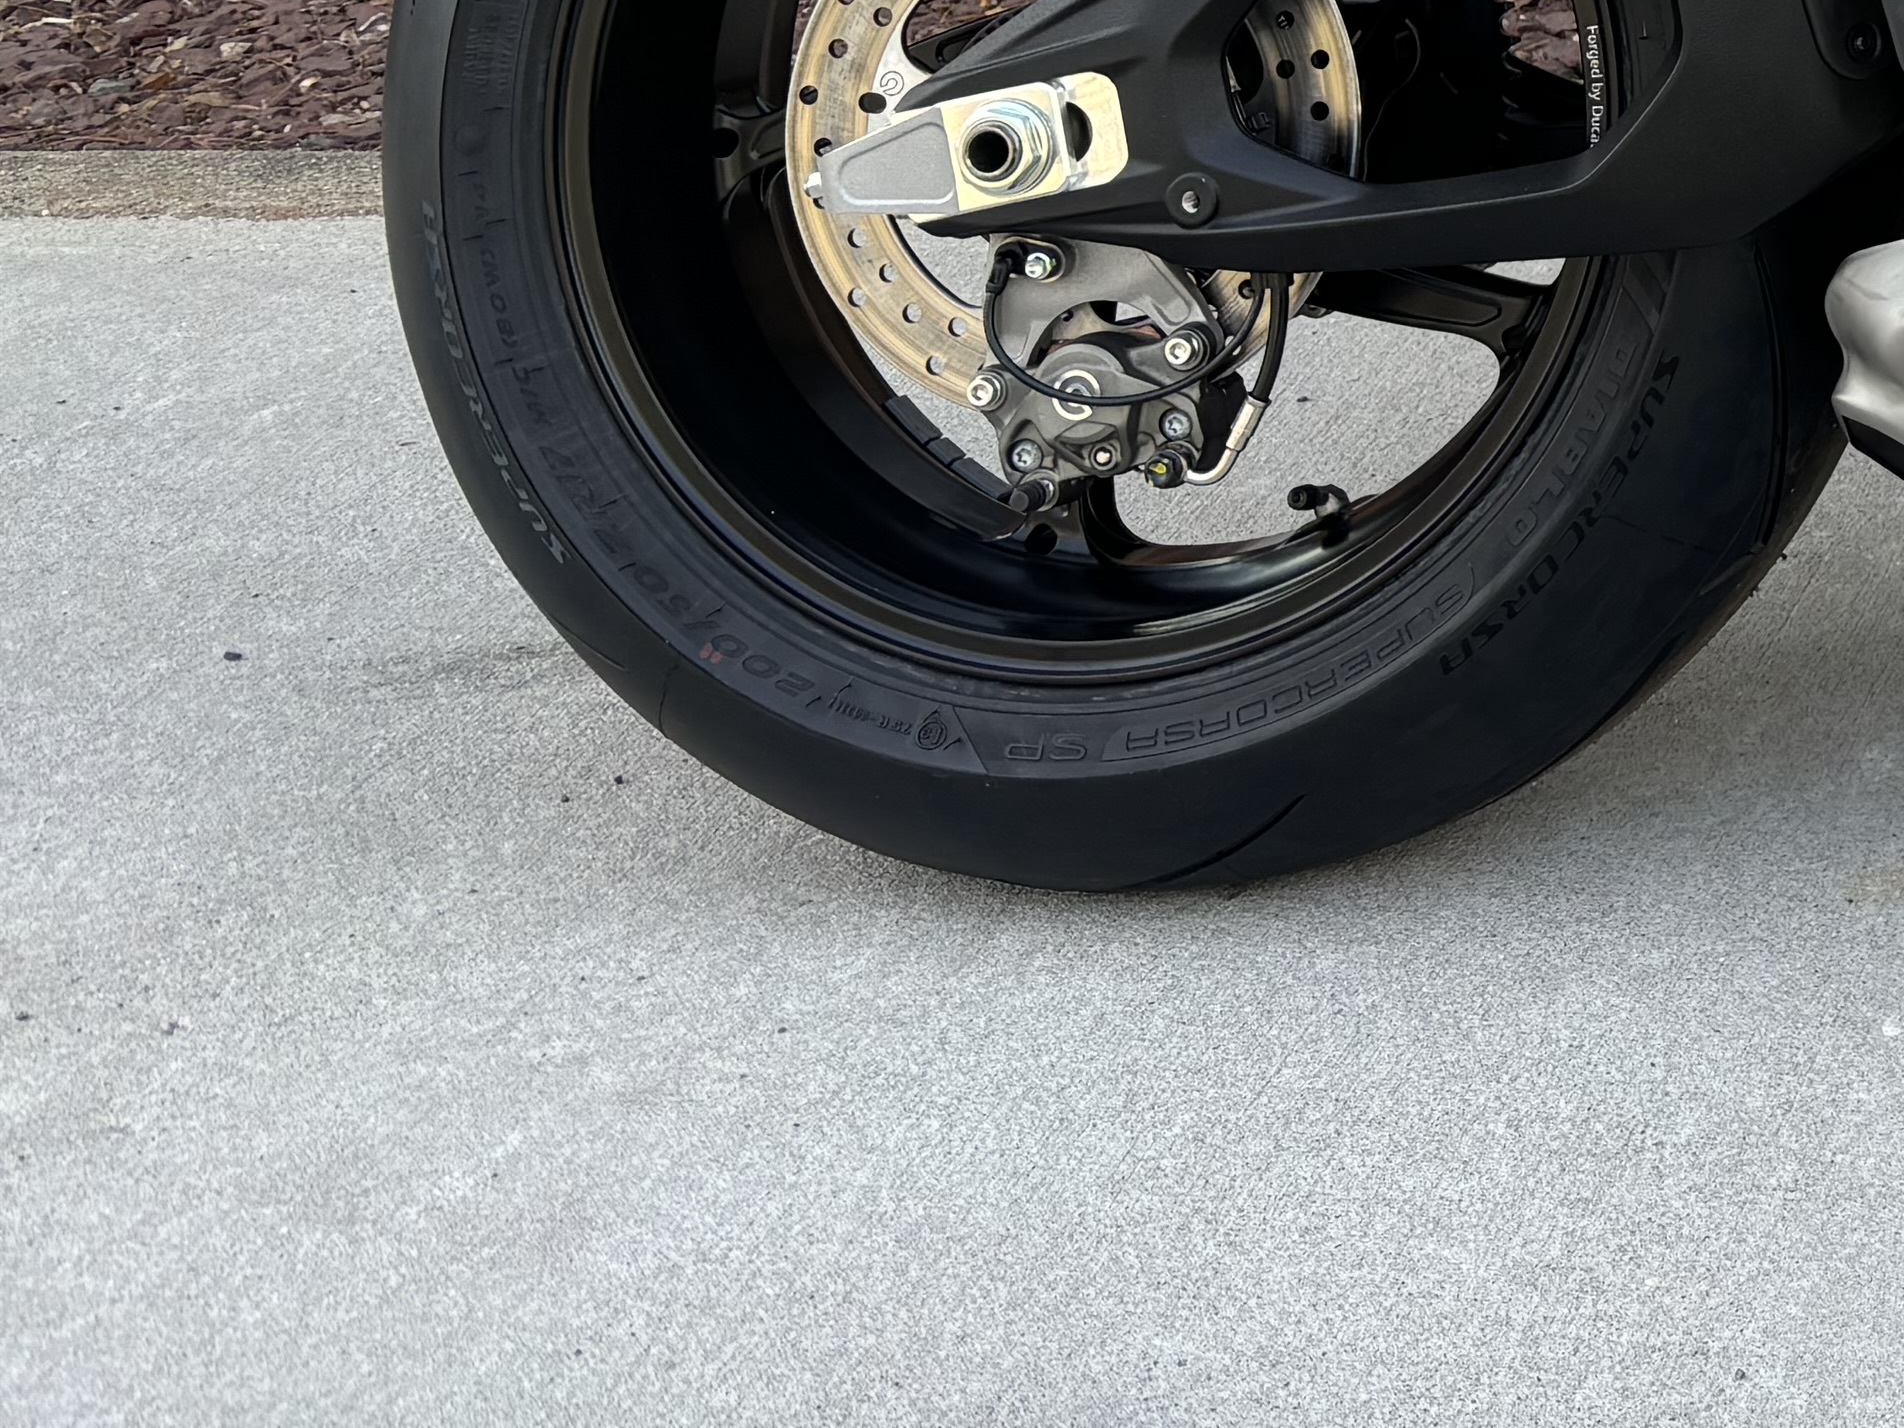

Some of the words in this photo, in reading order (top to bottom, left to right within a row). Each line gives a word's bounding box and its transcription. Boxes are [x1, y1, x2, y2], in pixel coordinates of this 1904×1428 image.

[1586, 25, 1604, 79] Forged
[1588, 82, 1605, 101] by
[1590, 105, 1604, 149] Duca
[421, 199, 572, 566] SUPERCORSA
[1510, 339, 1640, 549] DIABLO
[1440, 346, 1682, 677] SUPERCORSA
[1124, 584, 1470, 754] SUPERCORSA
[1005, 730, 1089, 762] SP
